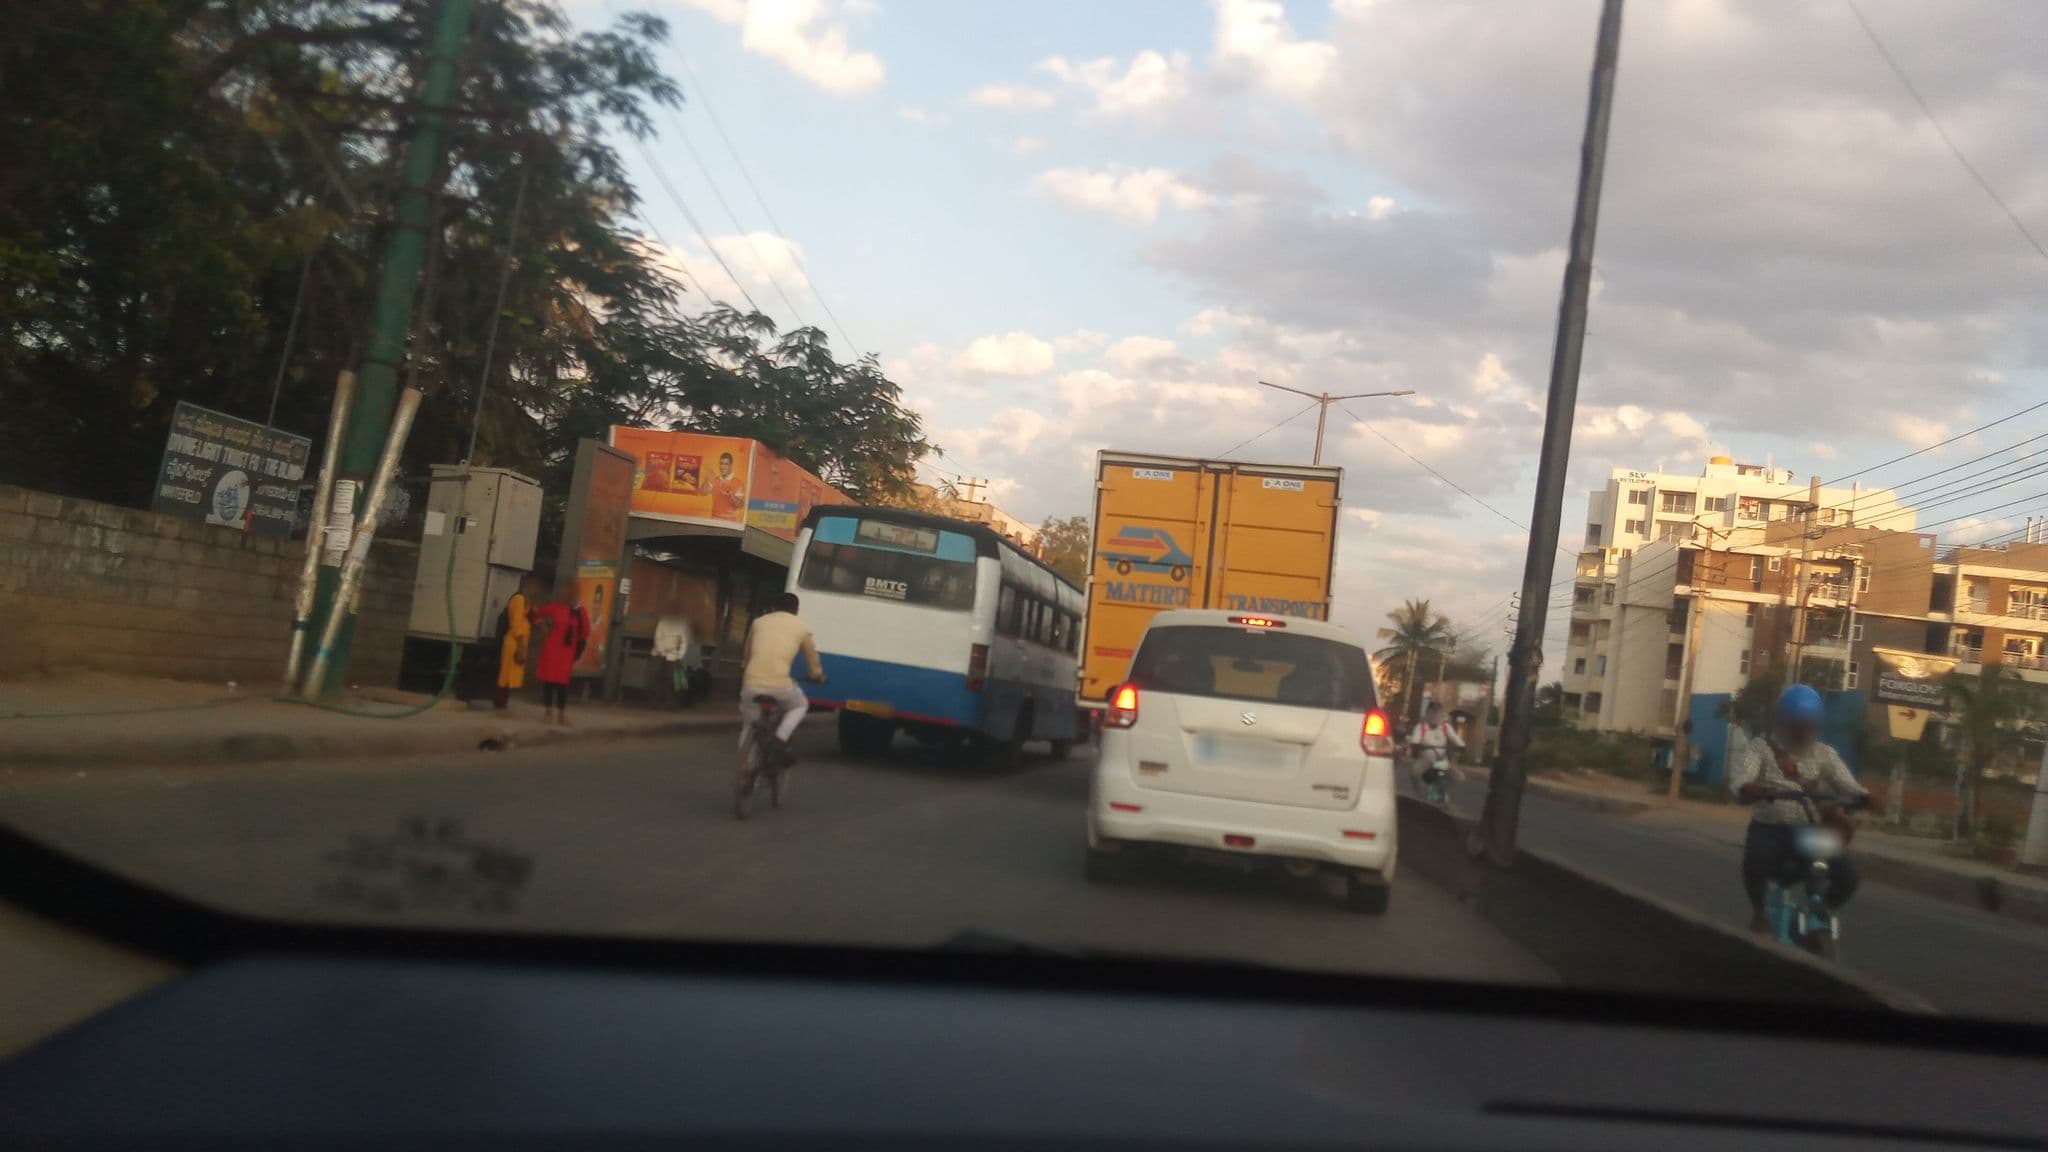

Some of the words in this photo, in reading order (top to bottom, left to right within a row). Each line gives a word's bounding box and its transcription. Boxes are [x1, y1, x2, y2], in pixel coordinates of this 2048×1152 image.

[865, 576, 908, 592] BMTC
[1106, 581, 1188, 605] MATHRU
[1226, 594, 1322, 619] TRANSPORT
